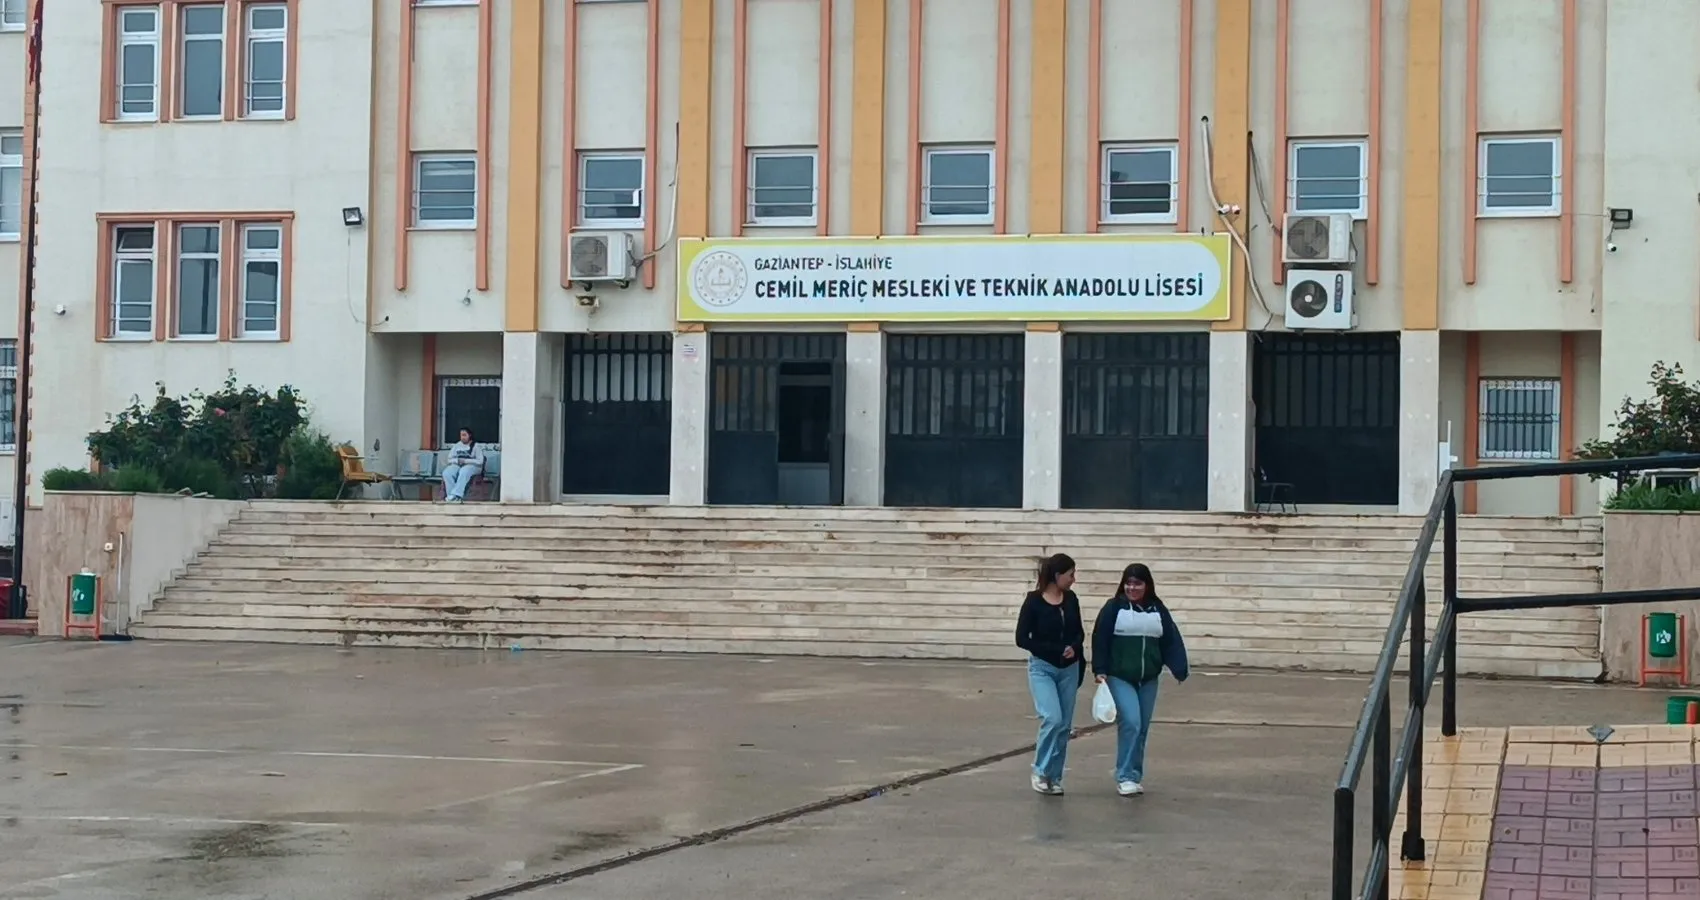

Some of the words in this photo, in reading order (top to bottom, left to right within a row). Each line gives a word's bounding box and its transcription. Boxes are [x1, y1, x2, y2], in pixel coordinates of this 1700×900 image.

[754, 255, 825, 270] GAZİANTEP
[835, 254, 893, 270] İSLAHİYE
[755, 275, 808, 298] CEMİL
[812, 274, 867, 302] MERİÇ
[872, 274, 950, 298] MESLEKİ
[954, 278, 976, 297] VE
[981, 273, 1048, 297] TEKNİK
[1052, 278, 1140, 297] ANADOLU
[1145, 272, 1203, 297] LİSESİ
